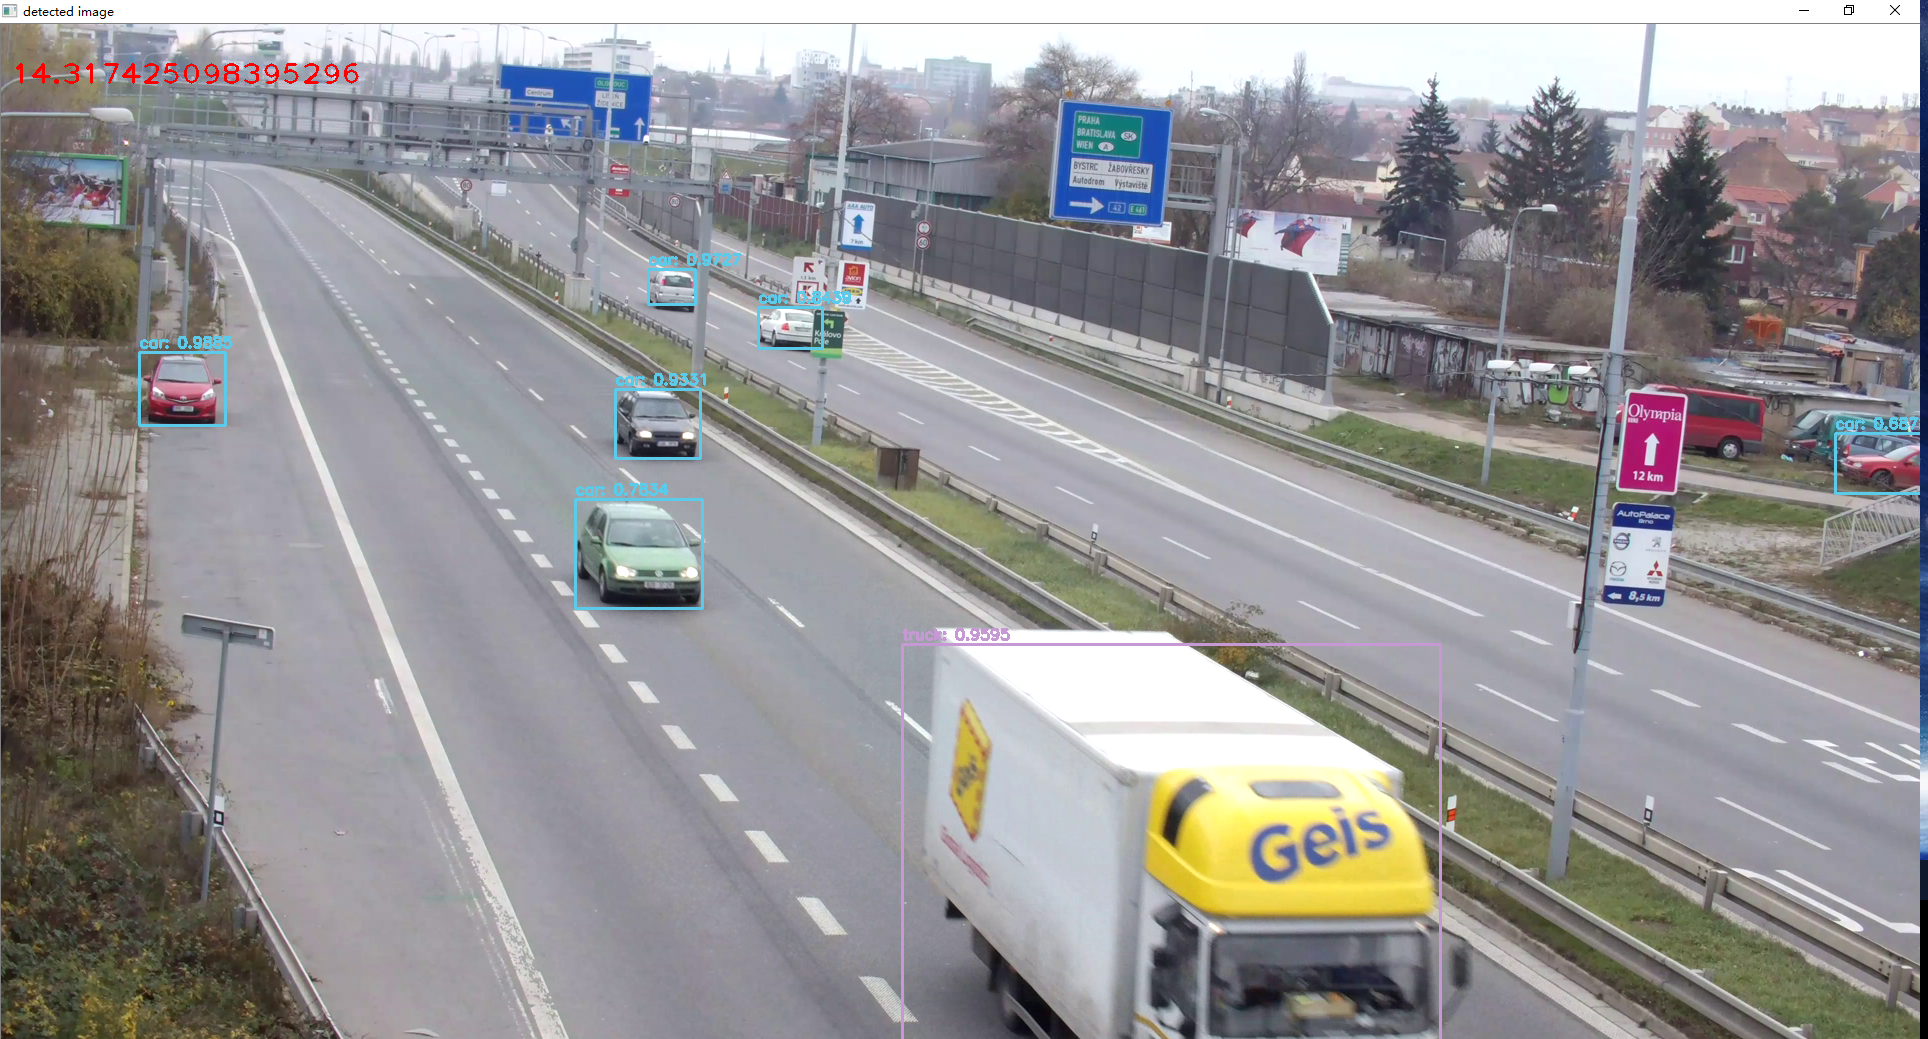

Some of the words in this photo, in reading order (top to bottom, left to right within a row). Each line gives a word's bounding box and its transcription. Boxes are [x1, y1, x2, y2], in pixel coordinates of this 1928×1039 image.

[597, 80, 626, 88] OLOOUC
[1077, 115, 1100, 125] PRAHA
[1076, 128, 1116, 139] BRATISLAVA
[1123, 132, 1134, 140] SK
[1076, 140, 1093, 149] WIEN
[1073, 162, 1098, 171] BYSTRC
[1107, 162, 1150, 174] ŽABOVŘESKY
[1072, 176, 1105, 186] Autodrom
[1114, 179, 1148, 190] Výstaviště
[1113, 204, 1121, 212] 42
[919, 239, 928, 247] 60
[1628, 403, 1682, 423] Olympia
[1633, 471, 1645, 480] 12
[1647, 471, 1664, 482] km
[1617, 510, 1671, 520] AutoPalace
[1628, 590, 1645, 602] 8,5
[1646, 593, 1661, 602] km
[1251, 806, 1391, 882] Geis
